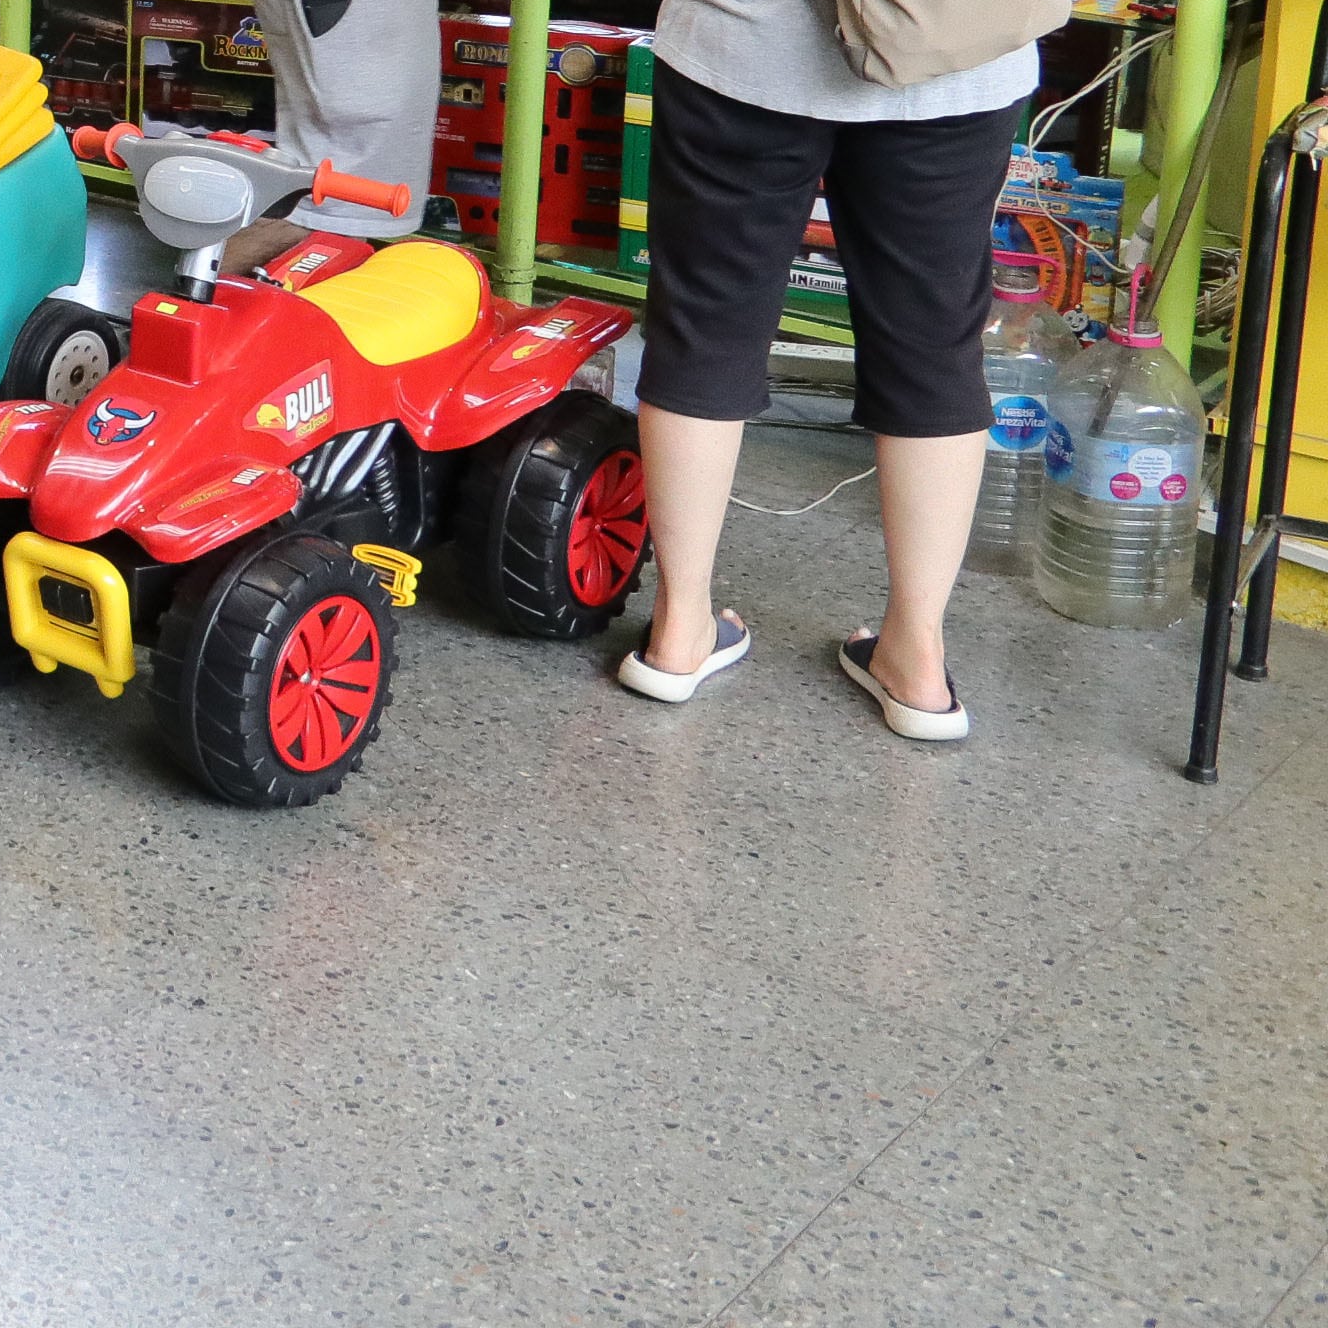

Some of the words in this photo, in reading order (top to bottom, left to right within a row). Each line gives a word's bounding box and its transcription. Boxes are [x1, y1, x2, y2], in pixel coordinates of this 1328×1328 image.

[285, 372, 332, 433] BULL
[996, 418, 1047, 429] urezaVital
[231, 468, 266, 485] BULL
